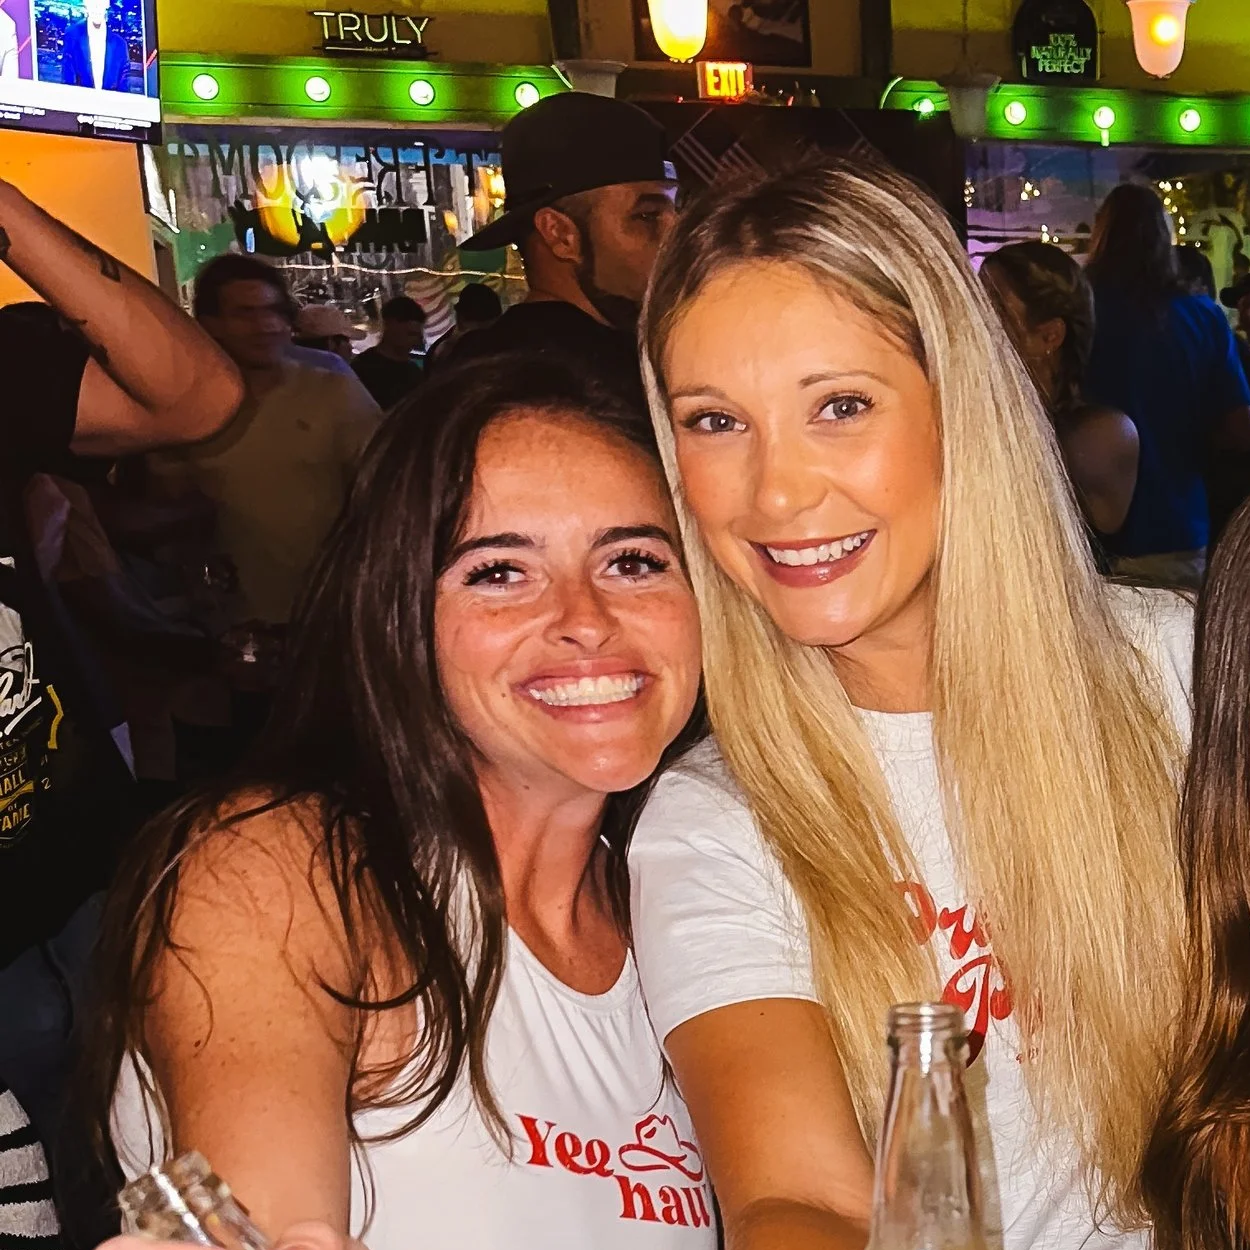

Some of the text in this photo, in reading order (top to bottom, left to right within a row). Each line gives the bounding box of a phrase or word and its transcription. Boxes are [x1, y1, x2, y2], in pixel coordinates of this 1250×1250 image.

[312, 11, 429, 44] TRULY
[706, 62, 747, 97] EXIT
[515, 1113, 614, 1177] Yee
